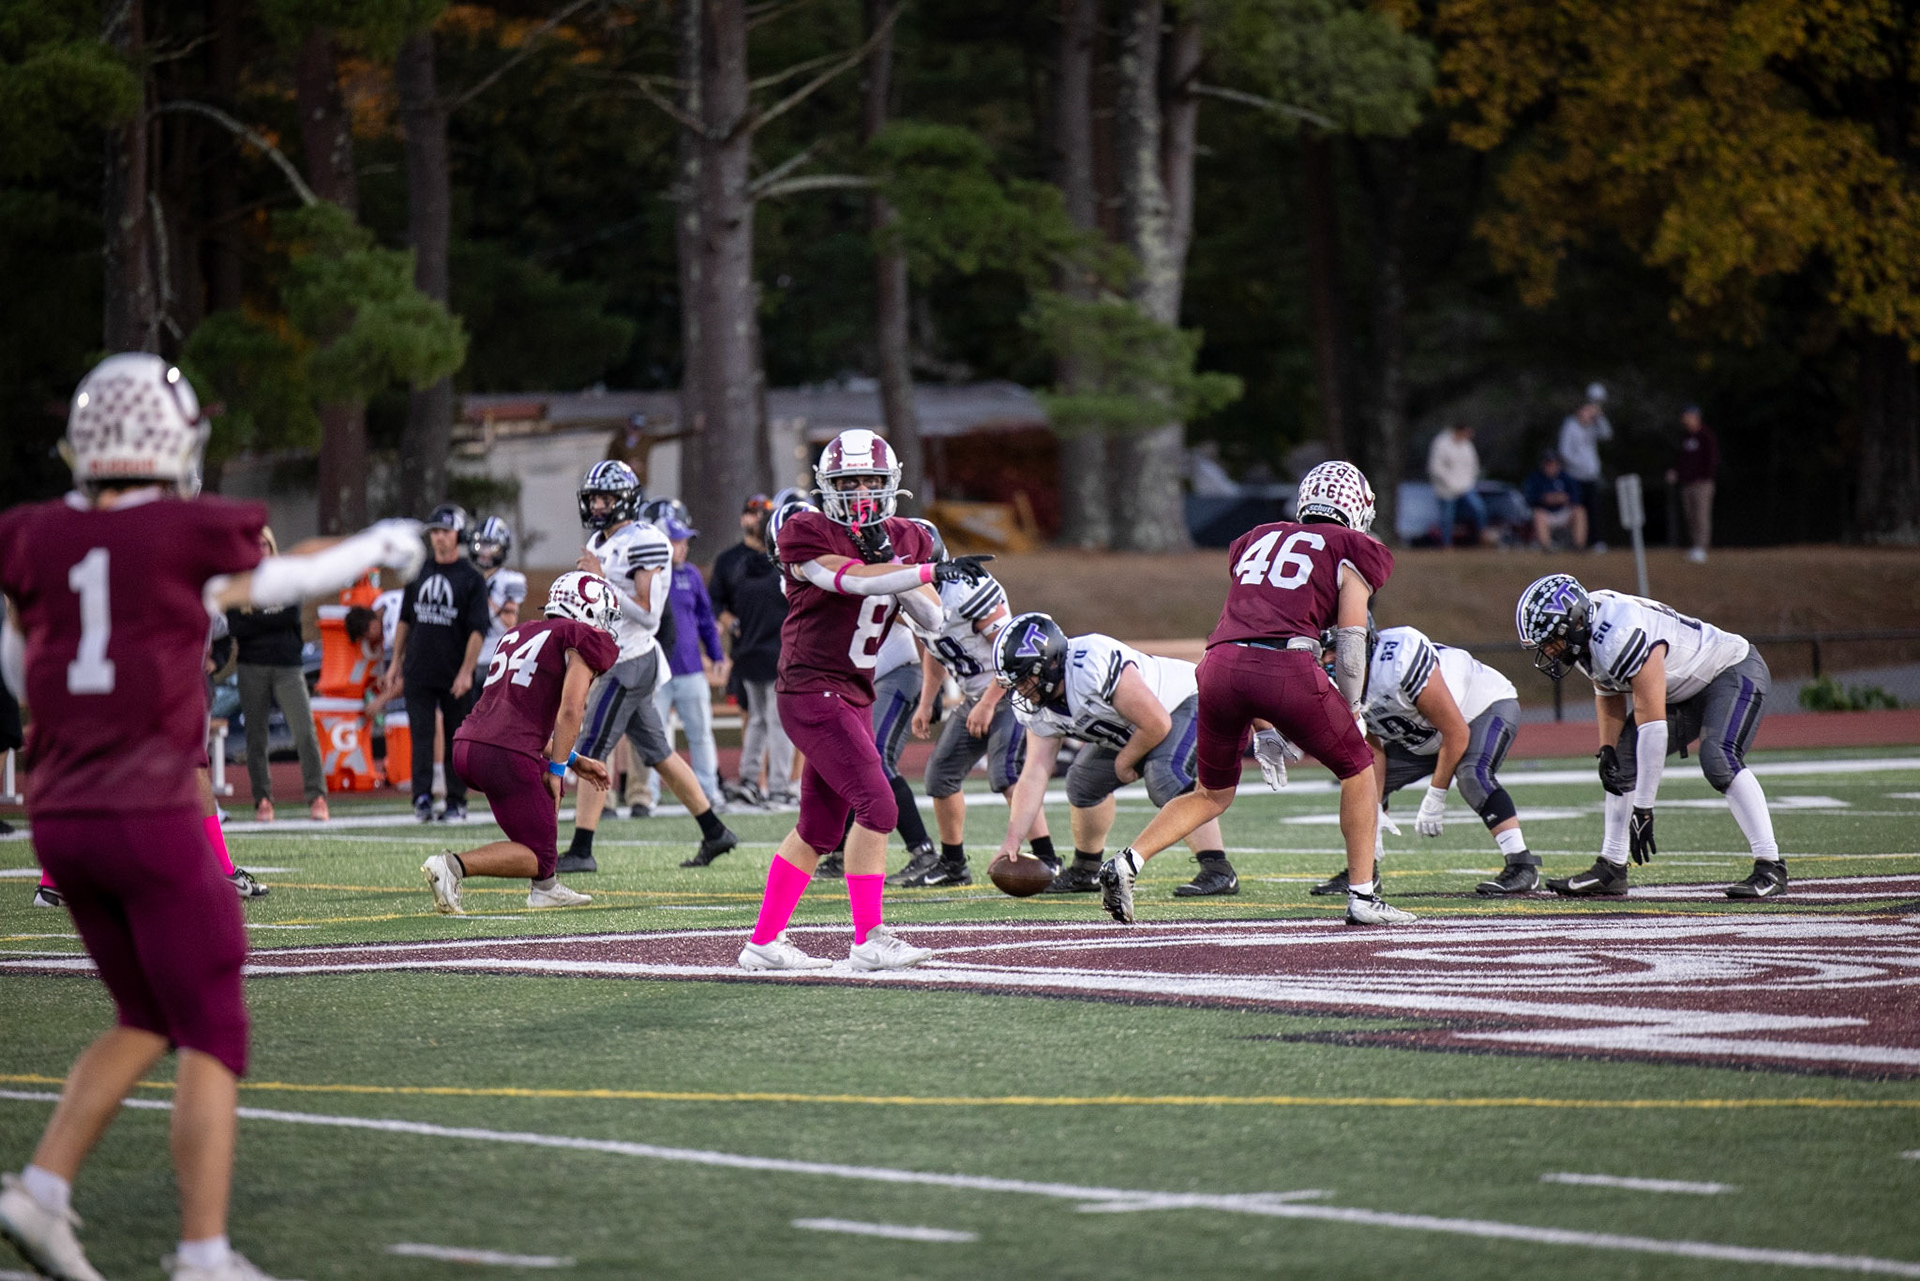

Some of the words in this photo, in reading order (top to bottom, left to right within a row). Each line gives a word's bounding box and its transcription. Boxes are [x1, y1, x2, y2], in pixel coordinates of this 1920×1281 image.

[1233, 530, 1326, 590] 46
[67, 546, 116, 695] 1
[1541, 582, 1579, 614] VT
[482, 629, 553, 689] 64
[848, 594, 898, 669] 8
[1014, 622, 1050, 657] VT
[331, 722, 357, 751] G
